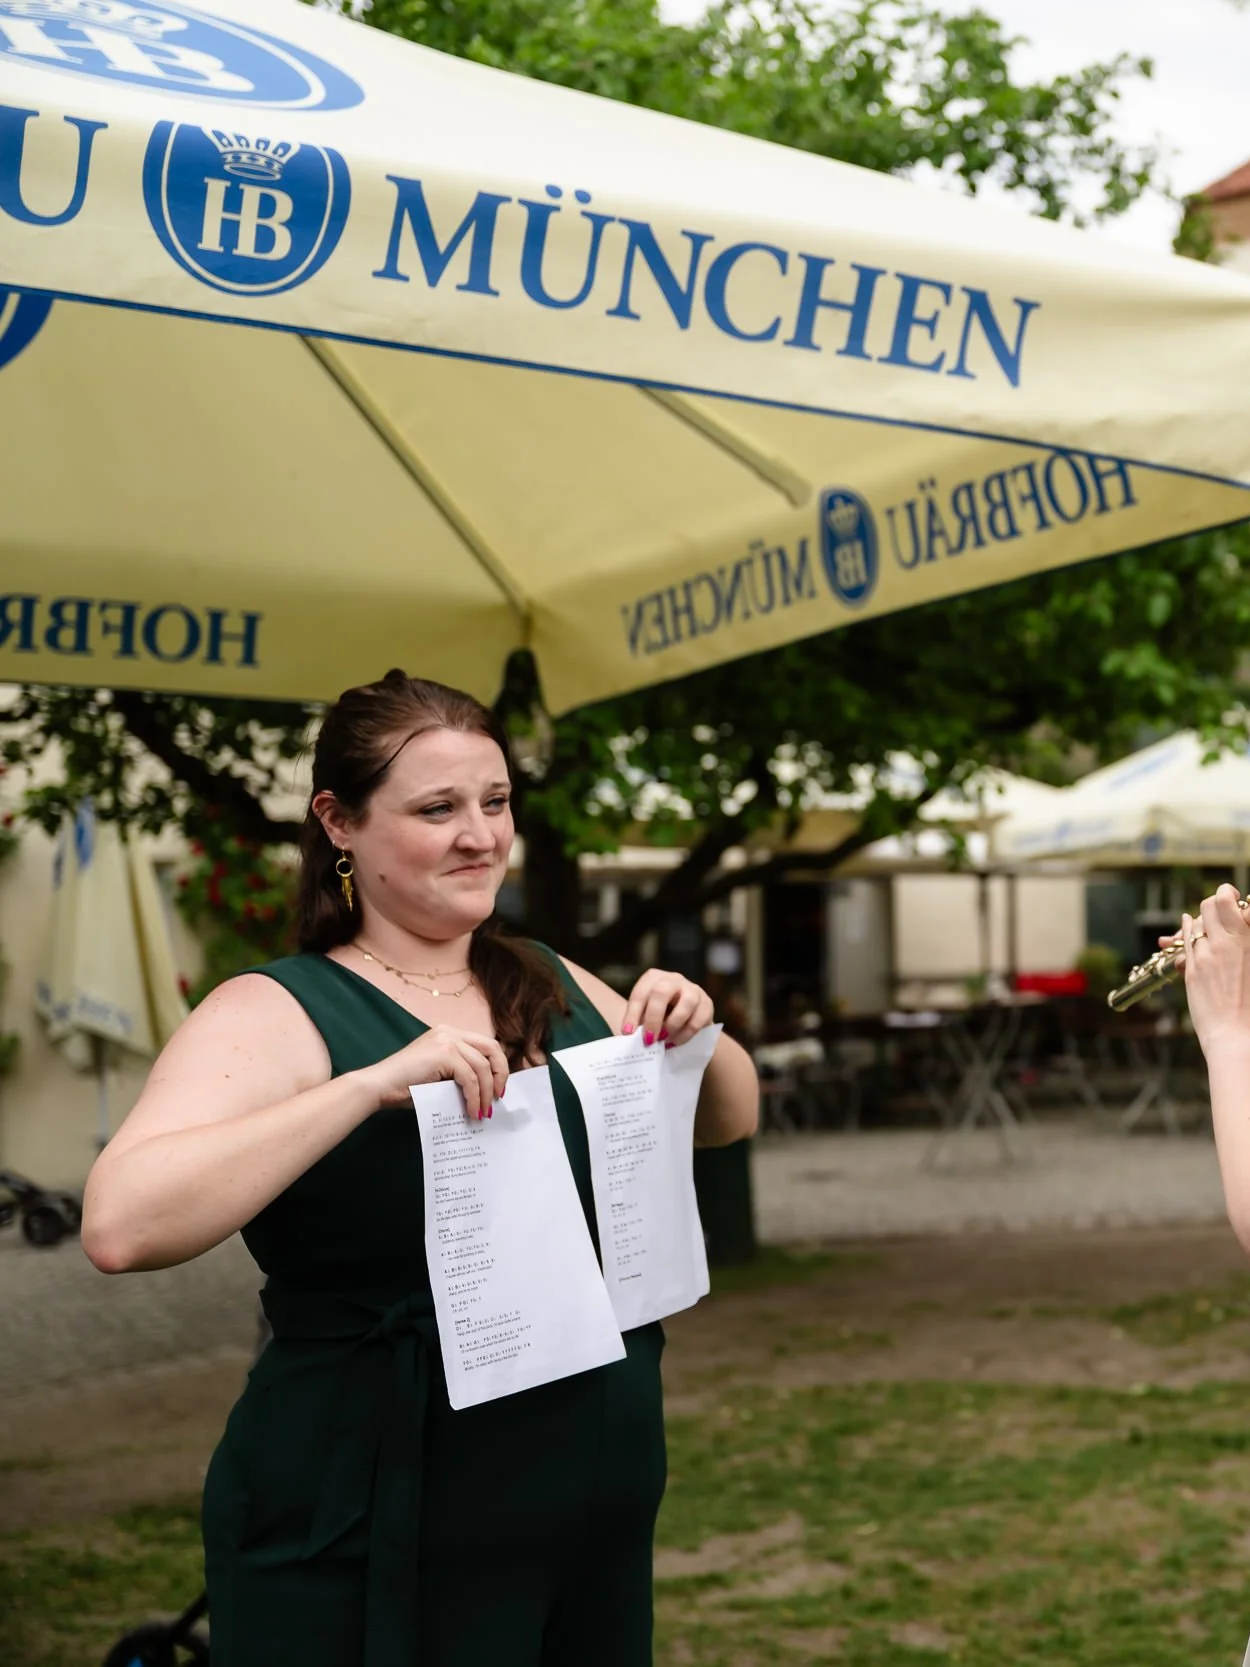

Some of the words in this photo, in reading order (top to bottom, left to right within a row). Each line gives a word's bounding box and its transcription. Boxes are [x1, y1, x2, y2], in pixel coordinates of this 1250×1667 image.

[0, 18, 255, 92] HB
[197, 176, 294, 261] HB
[372, 183, 1041, 388] MÜNCHEN
